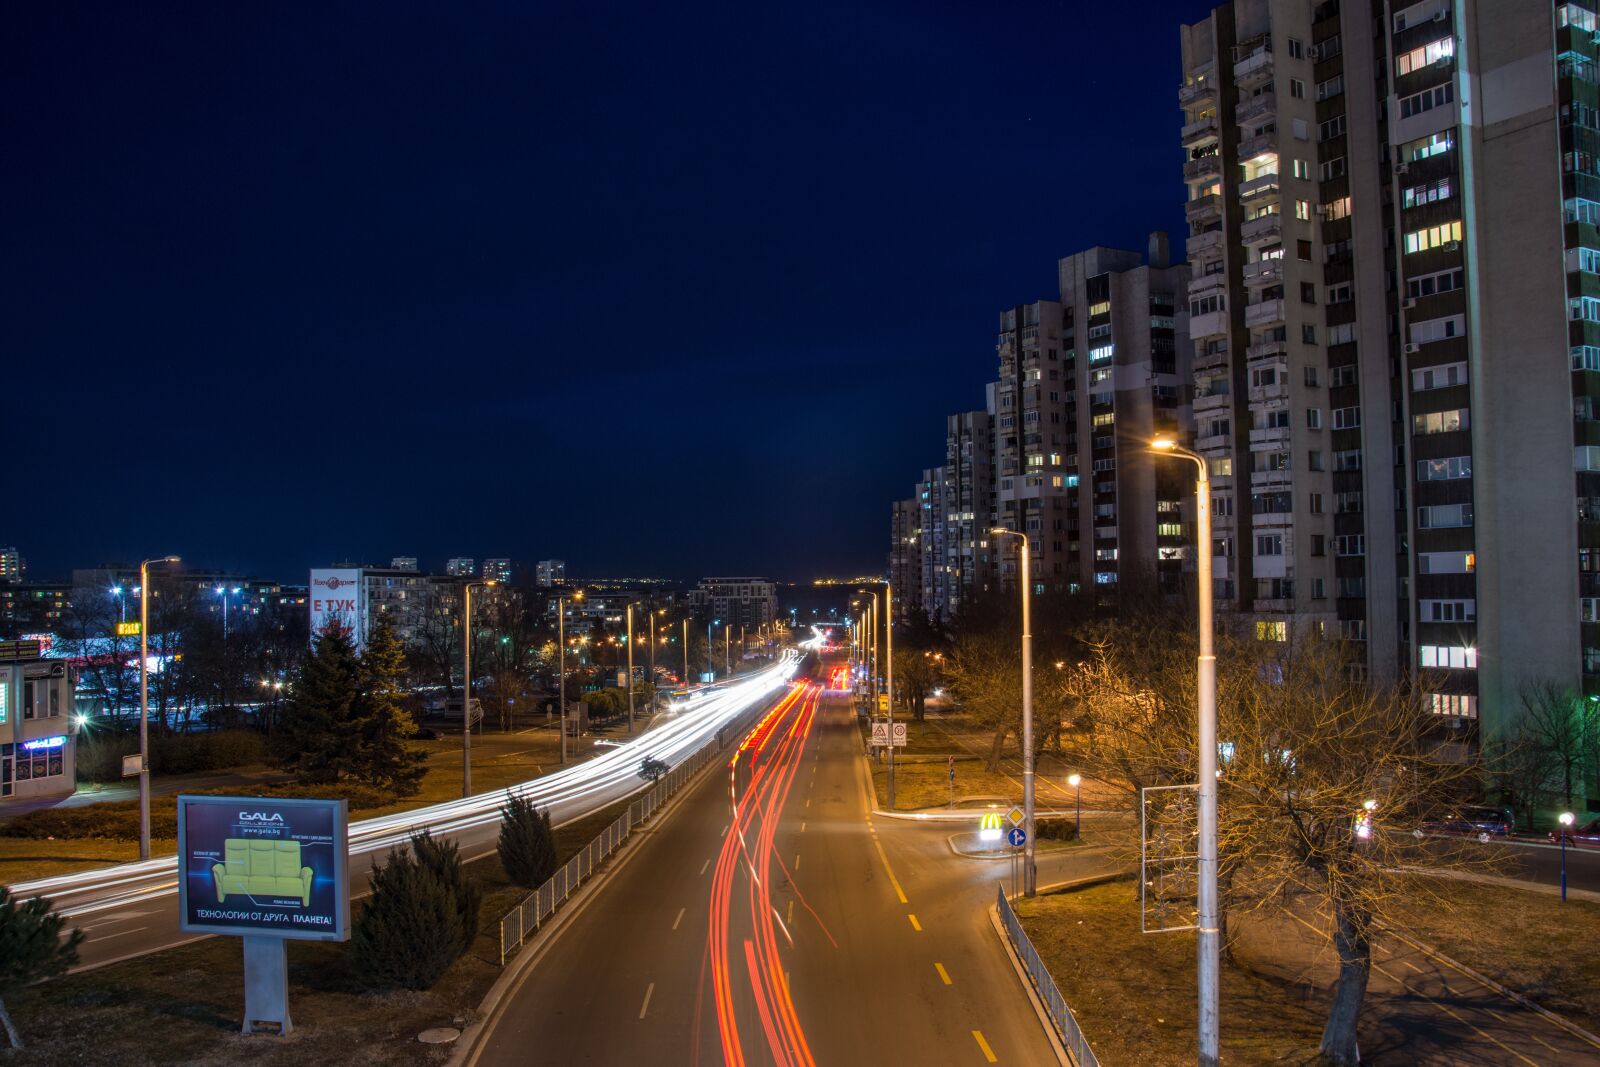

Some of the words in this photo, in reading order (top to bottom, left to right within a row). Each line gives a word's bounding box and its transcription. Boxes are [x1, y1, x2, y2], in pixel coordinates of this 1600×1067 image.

[325, 599, 356, 612] ТУК
[239, 811, 284, 822] GALA
[243, 828, 281, 836] www.gala.bg
[196, 909, 249, 920] ТЕХНОЛОГИИ
[251, 912, 262, 921] ОТ
[263, 913, 290, 922] ДРУГА
[293, 914, 333, 925] ПЛАНЕТА!
